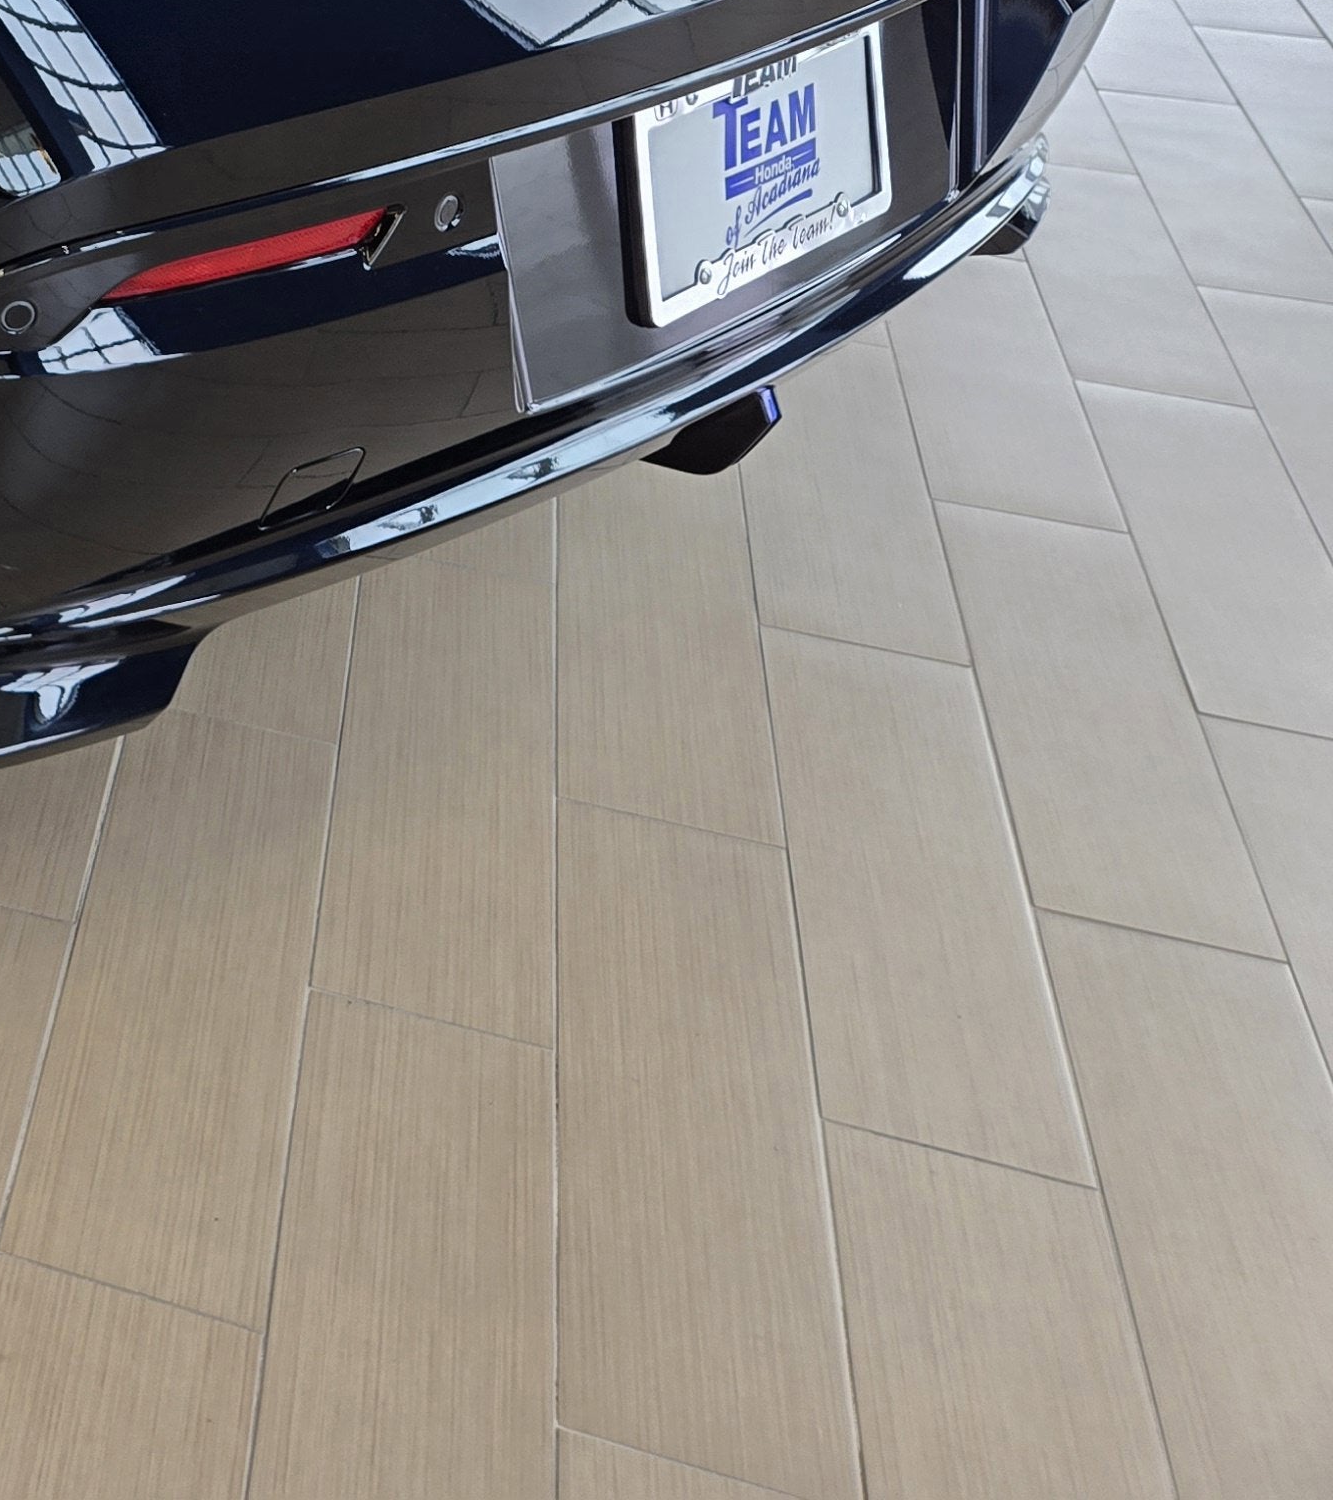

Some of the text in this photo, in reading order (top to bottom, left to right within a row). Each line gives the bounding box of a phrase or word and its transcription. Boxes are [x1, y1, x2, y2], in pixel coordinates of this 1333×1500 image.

[713, 83, 817, 171] TEAM
[726, 157, 821, 252] of Acadiana
[757, 231, 788, 265] The
